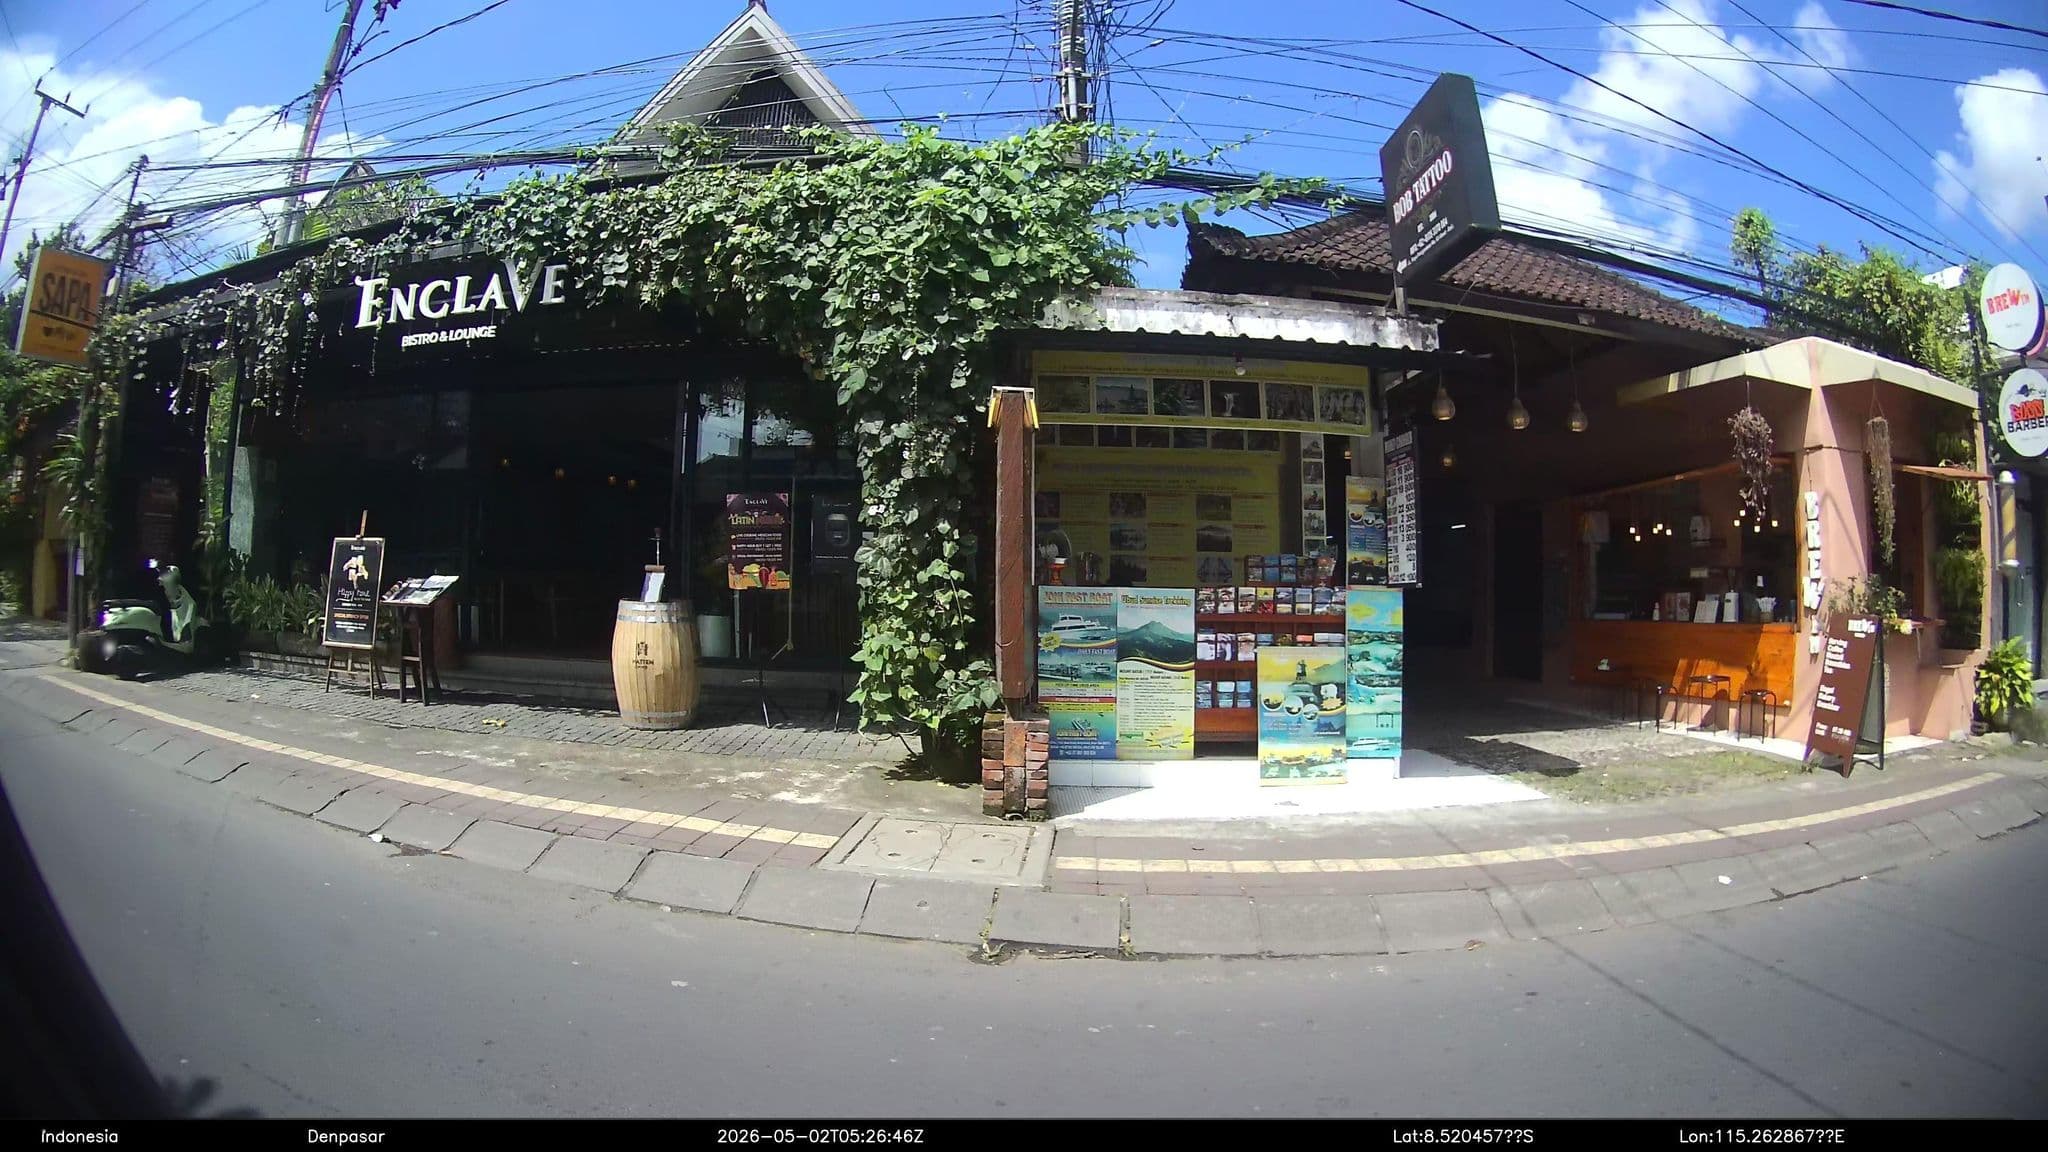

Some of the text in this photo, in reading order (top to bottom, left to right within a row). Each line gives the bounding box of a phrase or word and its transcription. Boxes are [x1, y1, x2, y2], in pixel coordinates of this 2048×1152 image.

[1393, 150, 1454, 224] BOB TATTOO
[39, 272, 92, 321] SAPA
[401, 325, 497, 348] BISTRO & LOUNGE
